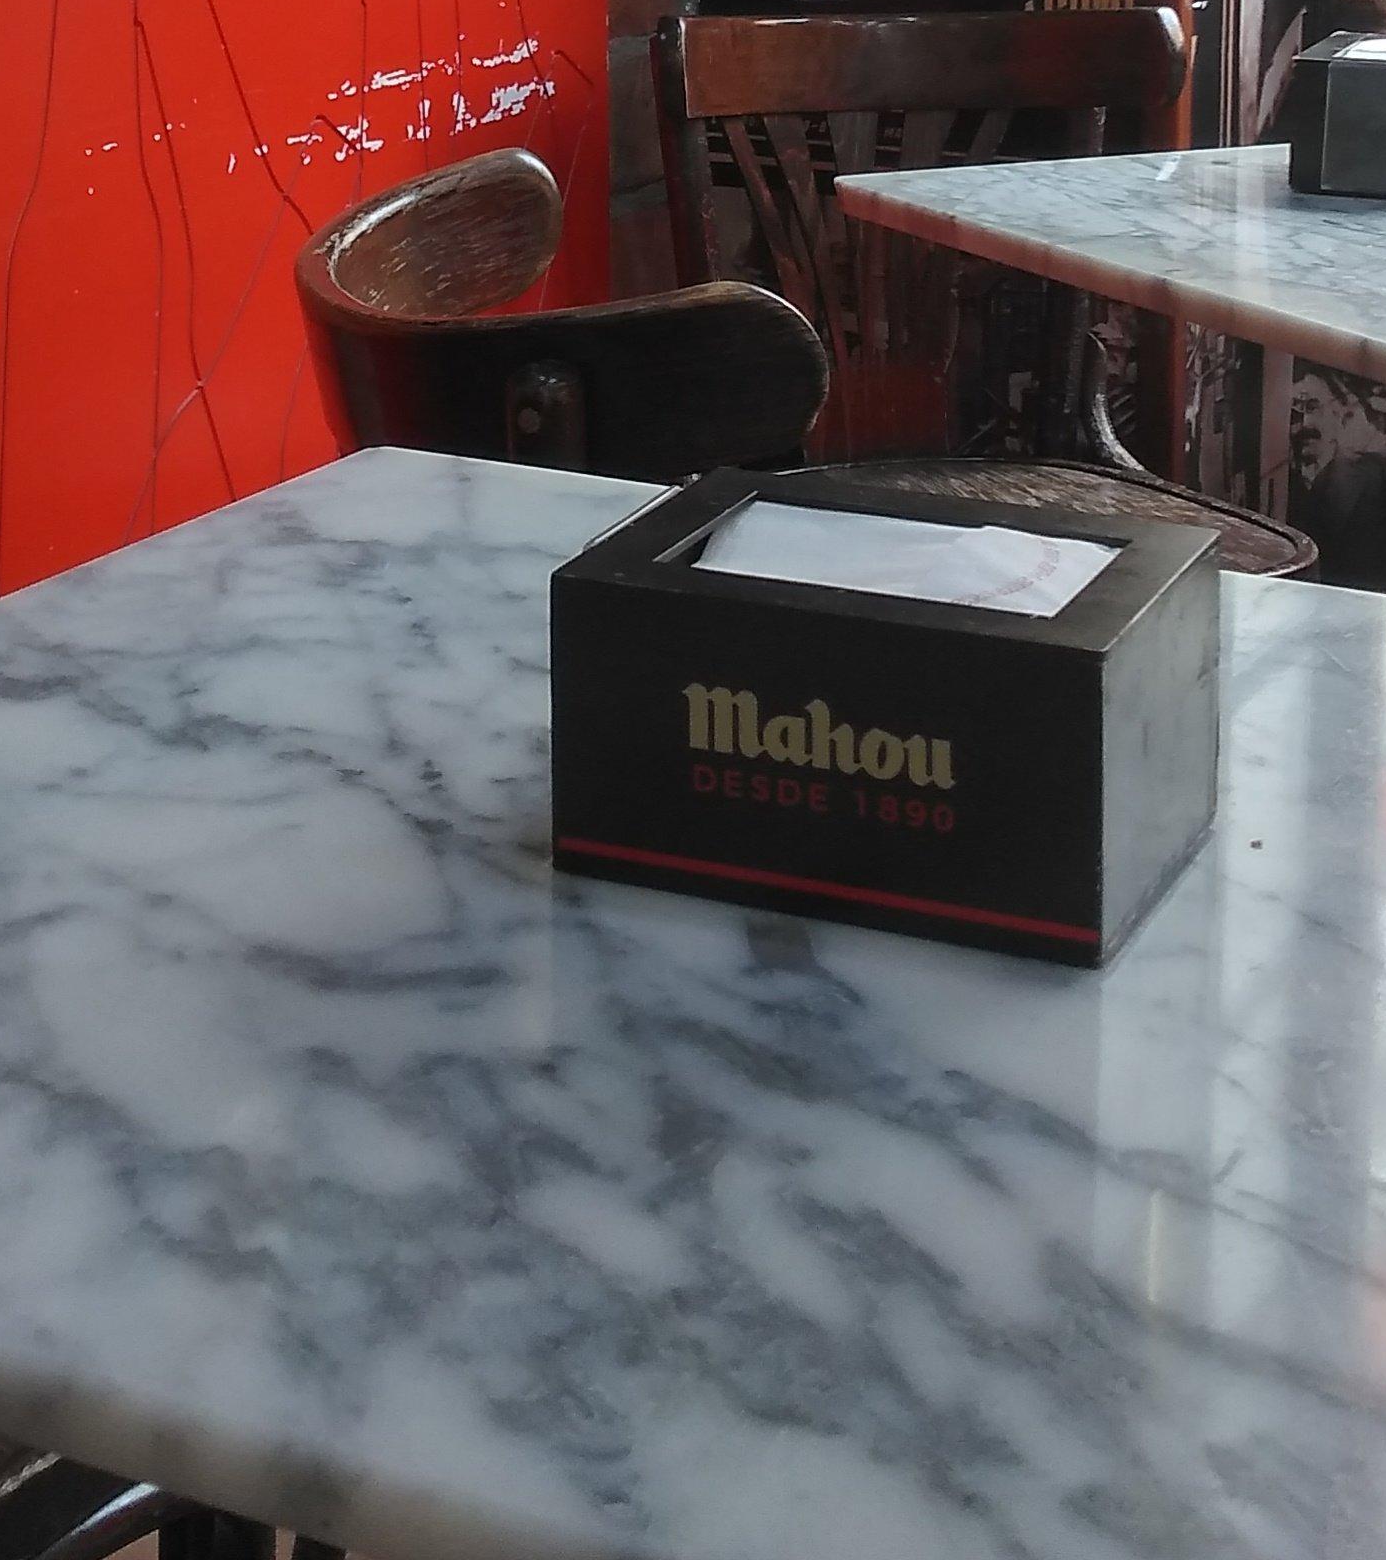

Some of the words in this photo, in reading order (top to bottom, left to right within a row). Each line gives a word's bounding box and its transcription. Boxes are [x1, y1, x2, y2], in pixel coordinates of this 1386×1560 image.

[681, 681, 957, 790] Mahou
[692, 764, 830, 814] DESDE
[854, 789, 957, 834] 1890
